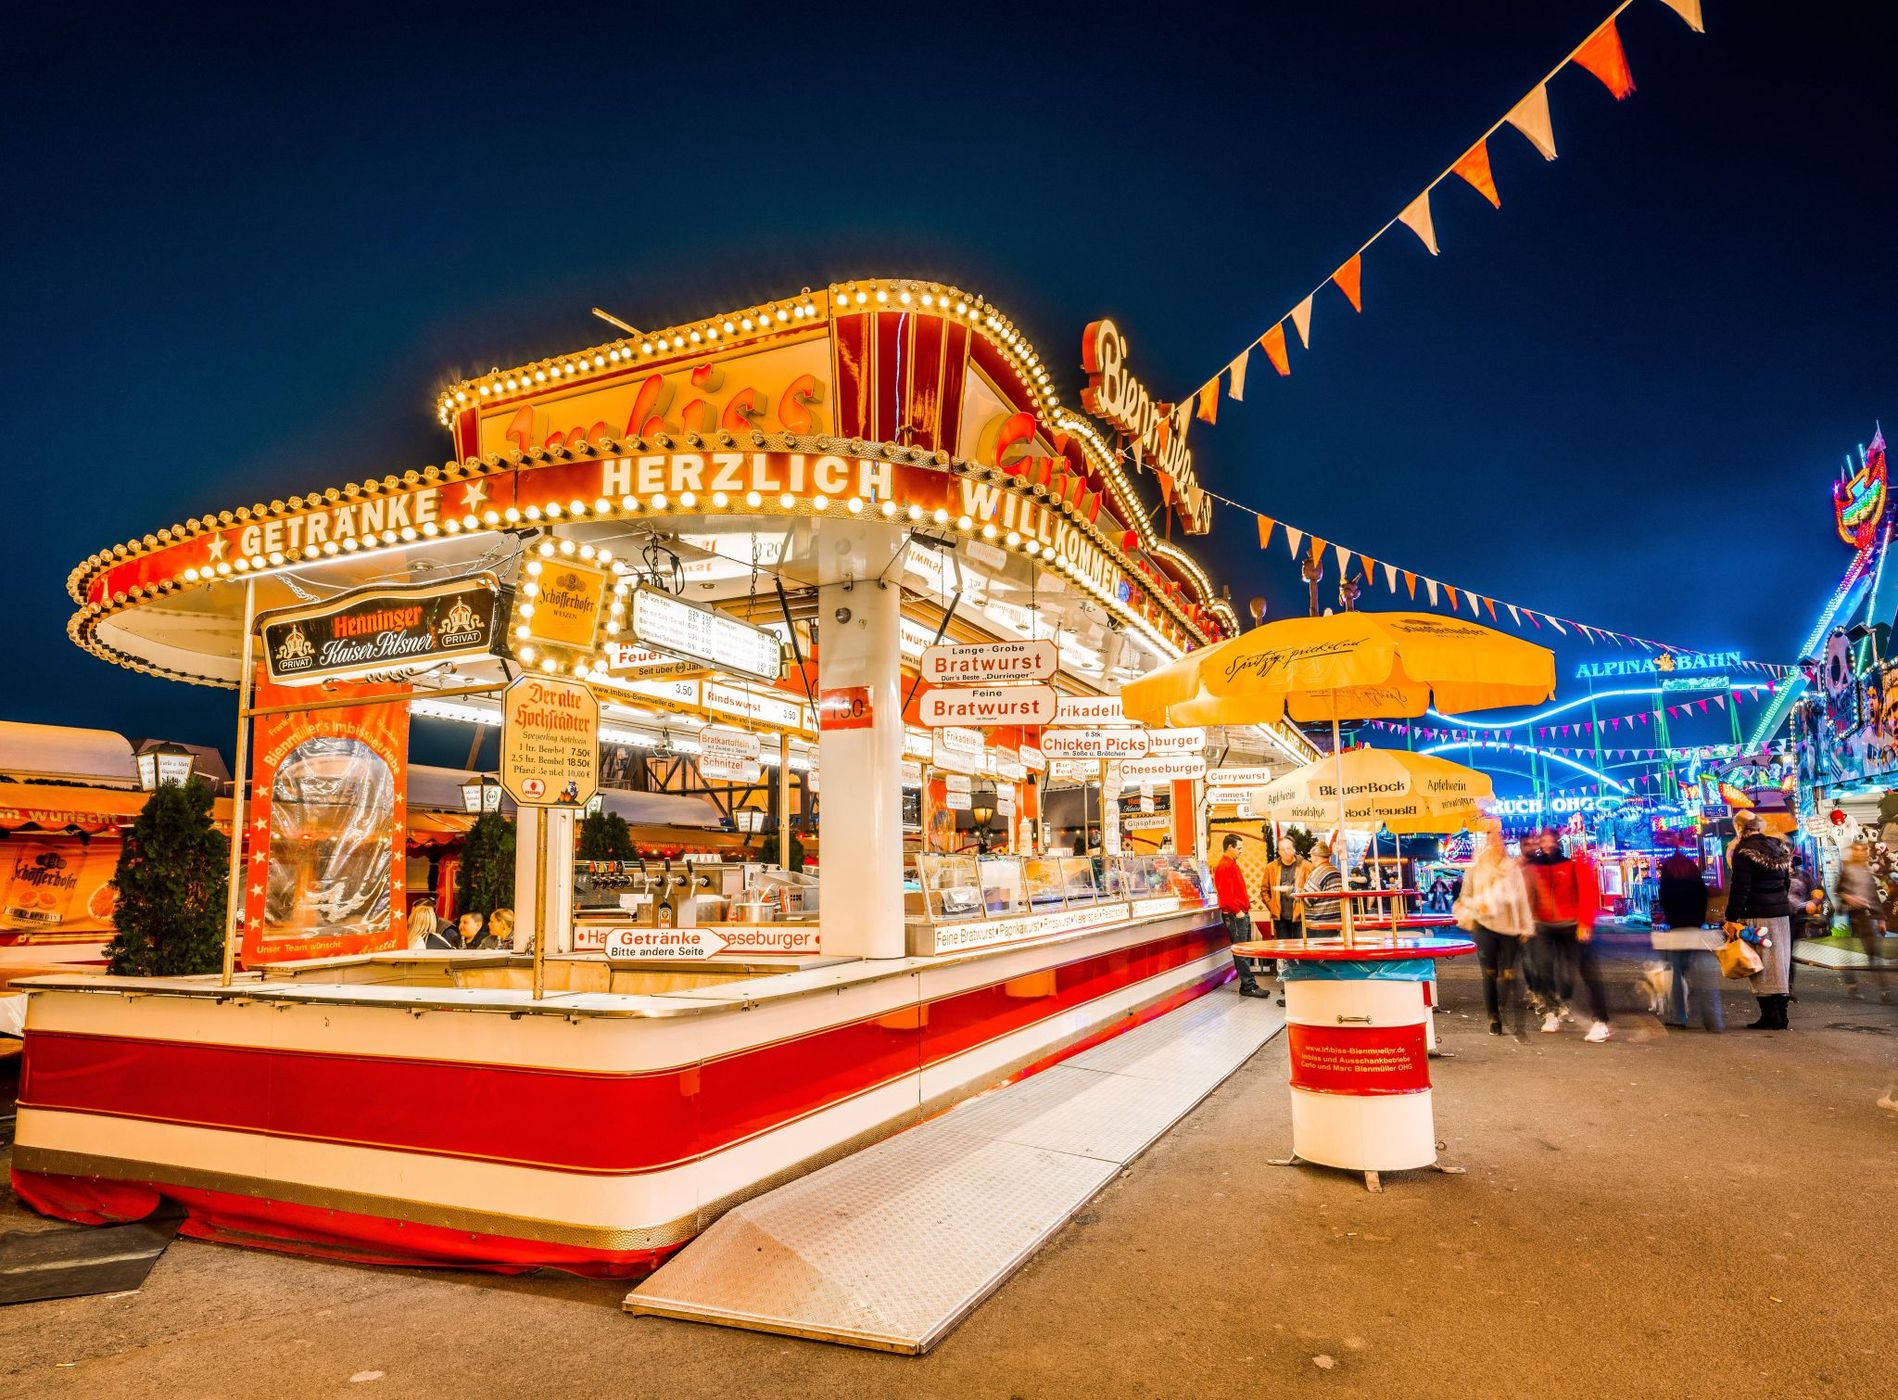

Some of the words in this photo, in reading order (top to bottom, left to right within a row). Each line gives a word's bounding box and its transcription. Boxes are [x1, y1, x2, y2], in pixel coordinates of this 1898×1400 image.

[602, 453, 894, 500] HERZLICH
[240, 488, 438, 557] GETRÄNKE
[962, 478, 1121, 598] WILLKOMMEN
[538, 583, 595, 614] Schöfferhofer
[333, 606, 424, 639] Henninger
[444, 633, 478, 645] PRIVAT
[319, 639, 374, 665] Kaiser
[373, 631, 433, 658] Pilsner
[952, 647, 985, 656] Lange
[992, 645, 1025, 653] Grobe
[282, 658, 309, 669] PRIVAT
[935, 653, 1042, 673] Bratwurst
[1576, 659, 1658, 678] ALPINA
[1676, 651, 1741, 670] BAHN
[638, 667, 654, 676] Seit
[655, 665, 673, 674] über
[528, 683, 558, 707] Der
[558, 689, 581, 710] alte
[675, 683, 693, 697] 3.50
[707, 692, 761, 713] Rindswurst
[934, 700, 1040, 716] Bratwurst
[1055, 704, 1125, 717] rikadell
[263, 720, 330, 768] Bienmüller's
[1043, 738, 1101, 751] Chicken
[1106, 737, 1147, 751] Picks
[538, 755, 565, 766] Bembel
[703, 756, 744, 770] Schnitzel
[1121, 763, 1205, 776] Cheeseburger
[1210, 772, 1266, 781] Currywurst
[1427, 779, 1467, 793] Apfelwein
[1493, 798, 1544, 814] RUCH
[1551, 797, 1594, 813] OHG
[1127, 819, 1165, 827] Glaspfand
[620, 931, 701, 945] Getränke
[936, 929, 959, 946] Feine
[960, 925, 996, 943] Bratwurst
[256, 945, 281, 954] Unser
[286, 944, 307, 952] Team
[611, 947, 636, 956] Bitte
[639, 947, 675, 956] andere
[678, 946, 704, 956] Seite
[1333, 1064, 1353, 1072] Marc
[1398, 1063, 1413, 1071] OHG
[1339, 1056, 1411, 1065] Ausschankbetriebe
